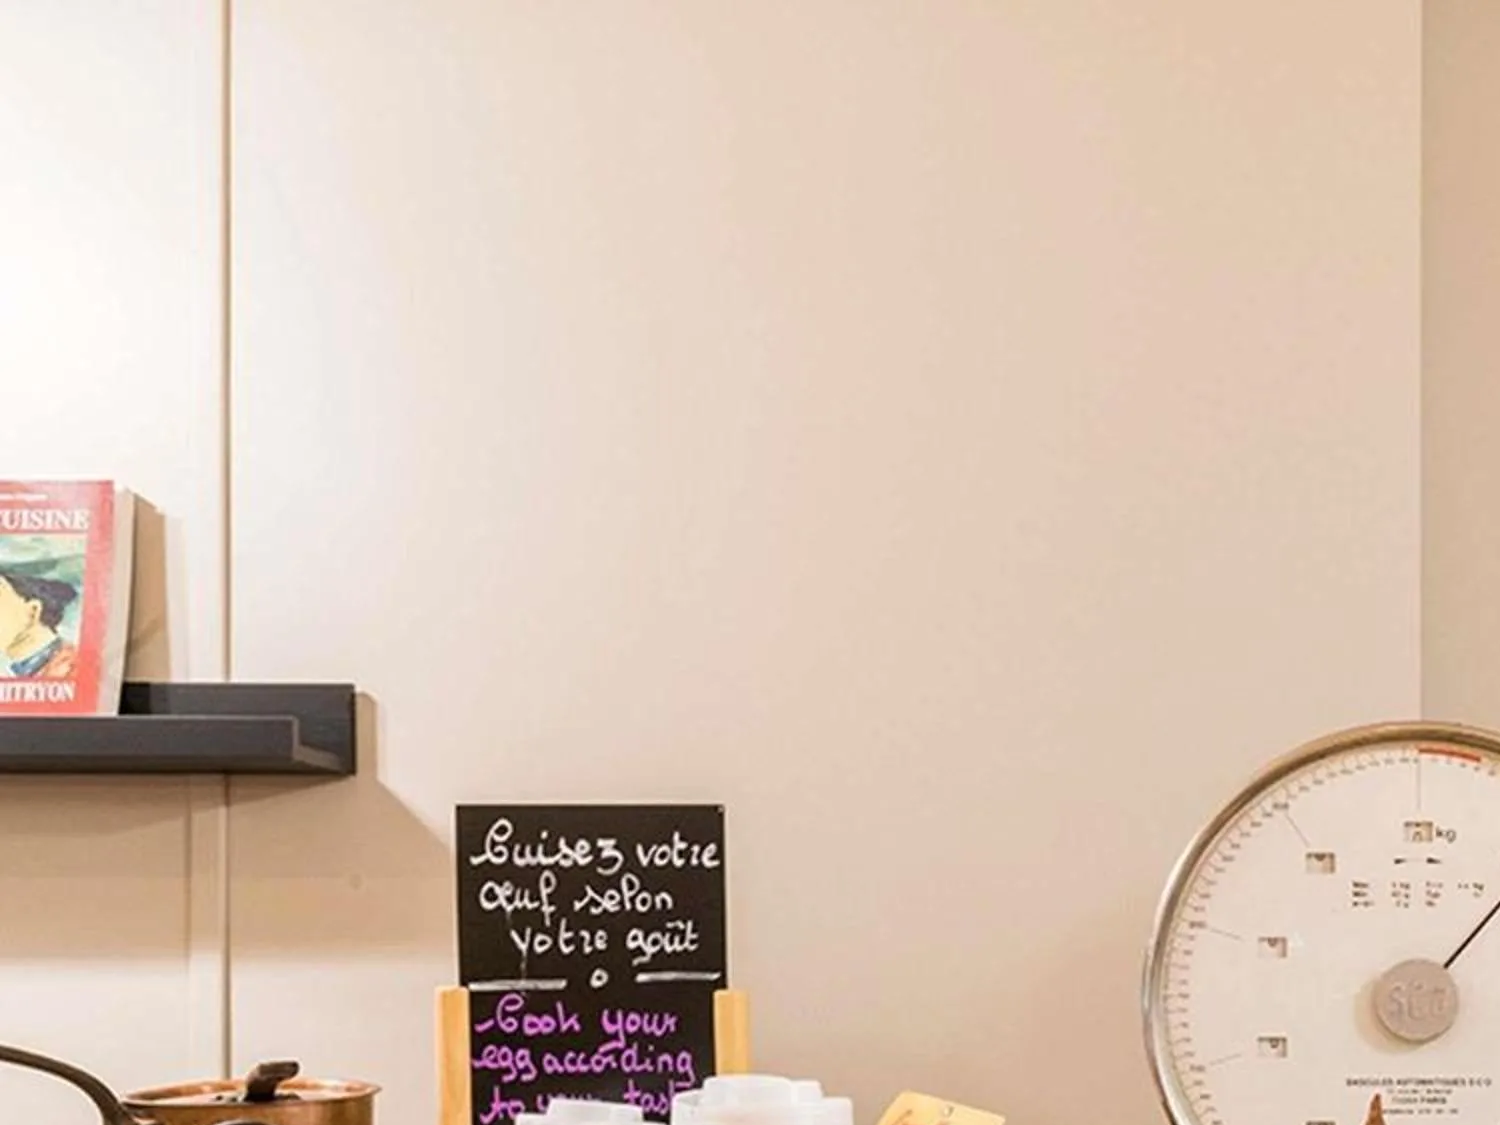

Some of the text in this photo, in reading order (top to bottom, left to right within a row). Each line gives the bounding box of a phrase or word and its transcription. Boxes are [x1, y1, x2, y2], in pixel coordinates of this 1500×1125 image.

[0, 508, 90, 530] UISINE
[637, 832, 720, 868] votre
[1436, 827, 1457, 843] kg
[574, 874, 674, 914] selon
[626, 920, 700, 967] goût
[601, 1009, 679, 1052] your
[472, 1045, 697, 1089] egg according
[480, 1087, 525, 1125] to
